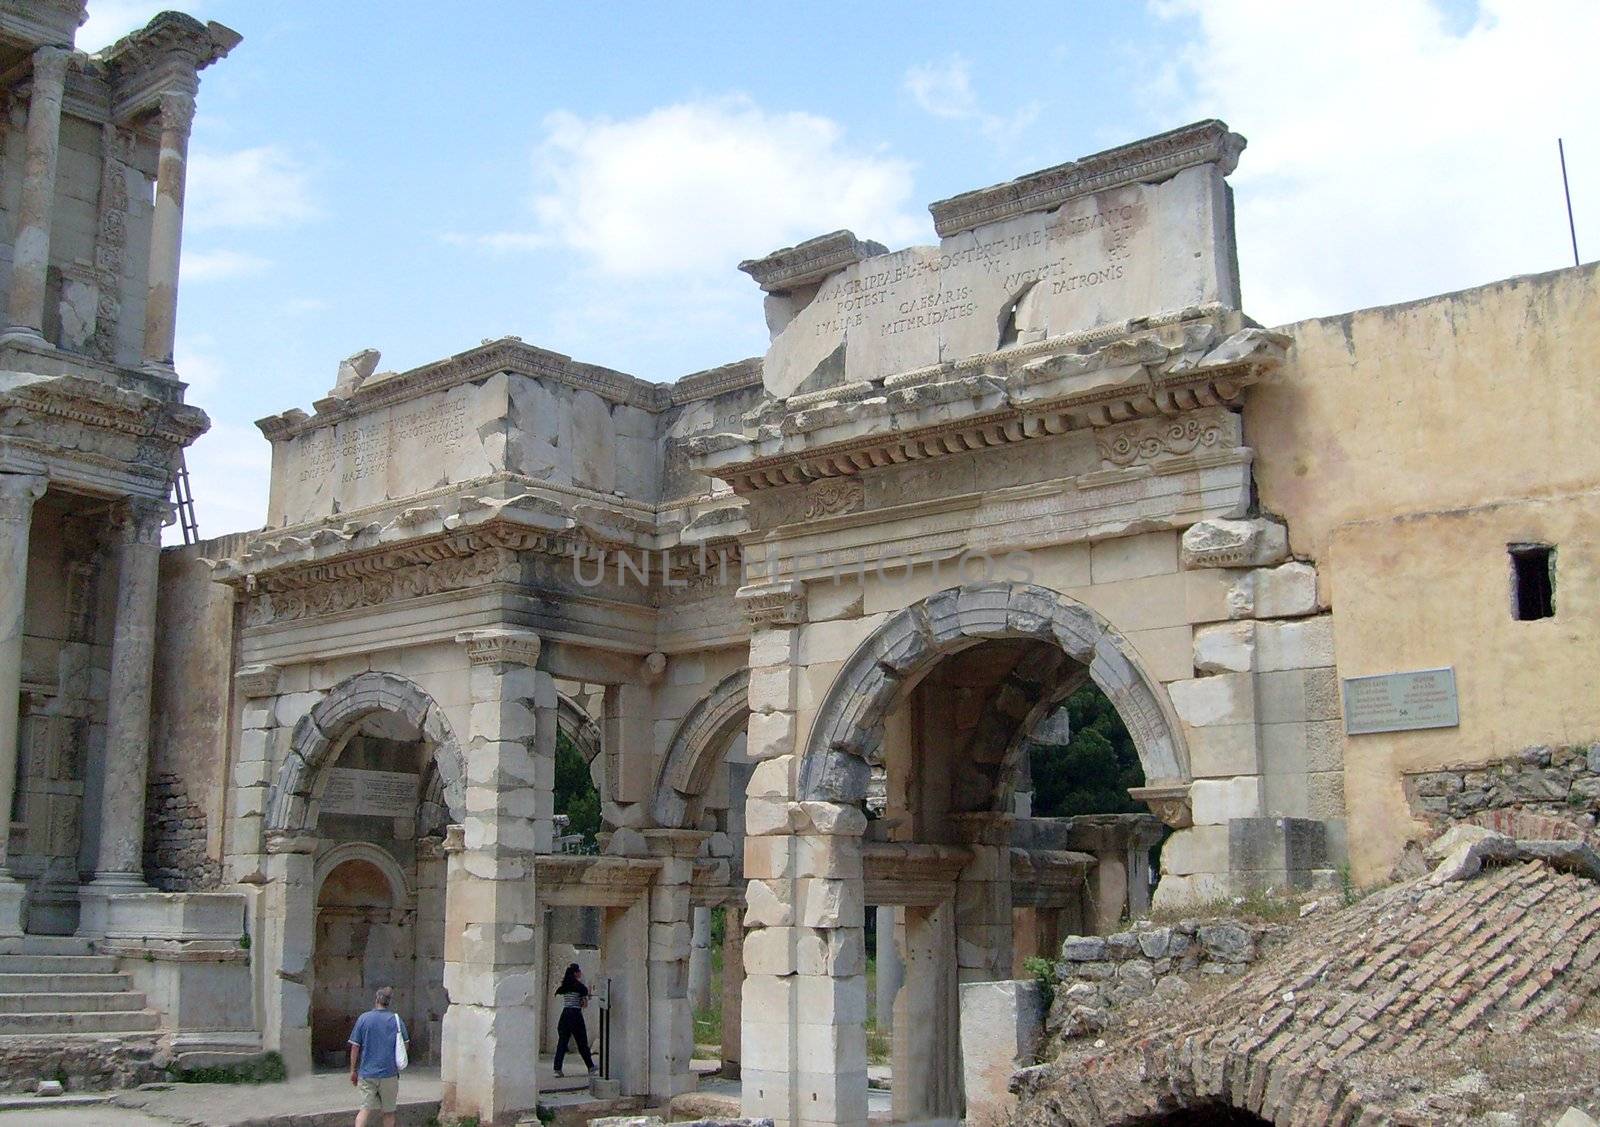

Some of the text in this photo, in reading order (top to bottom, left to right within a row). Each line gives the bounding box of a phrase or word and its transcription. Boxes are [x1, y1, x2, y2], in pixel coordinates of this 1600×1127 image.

[1052, 264, 1124, 296] PATRONIS
[837, 290, 888, 314] POTEST
[899, 286, 968, 315] CAESARIS
